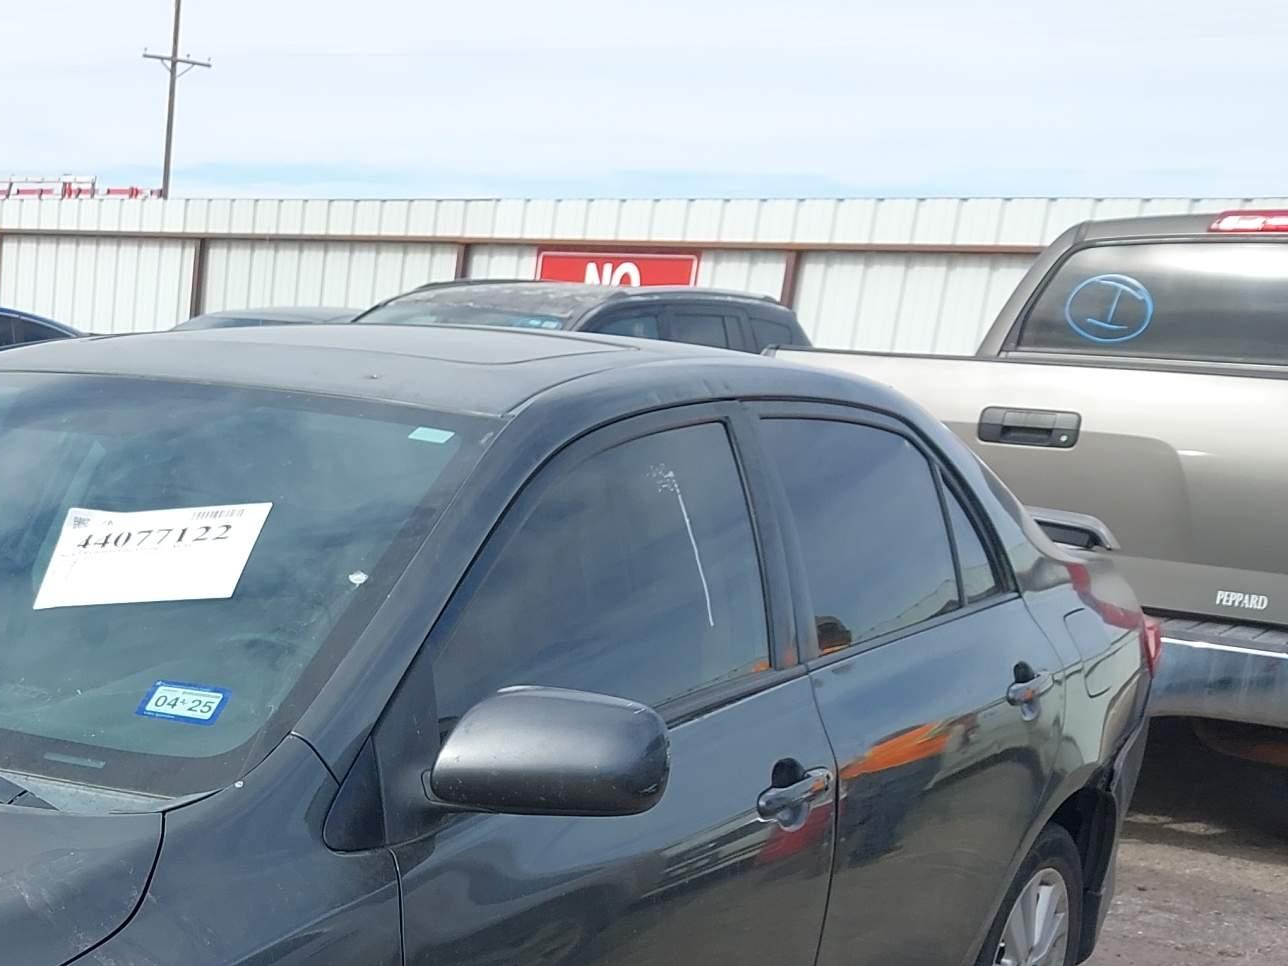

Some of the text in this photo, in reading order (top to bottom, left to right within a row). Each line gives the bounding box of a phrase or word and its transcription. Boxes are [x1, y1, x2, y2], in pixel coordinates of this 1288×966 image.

[584, 261, 641, 287] NO
[77, 524, 232, 549] 44077122
[1215, 590, 1269, 610] PEPPARD
